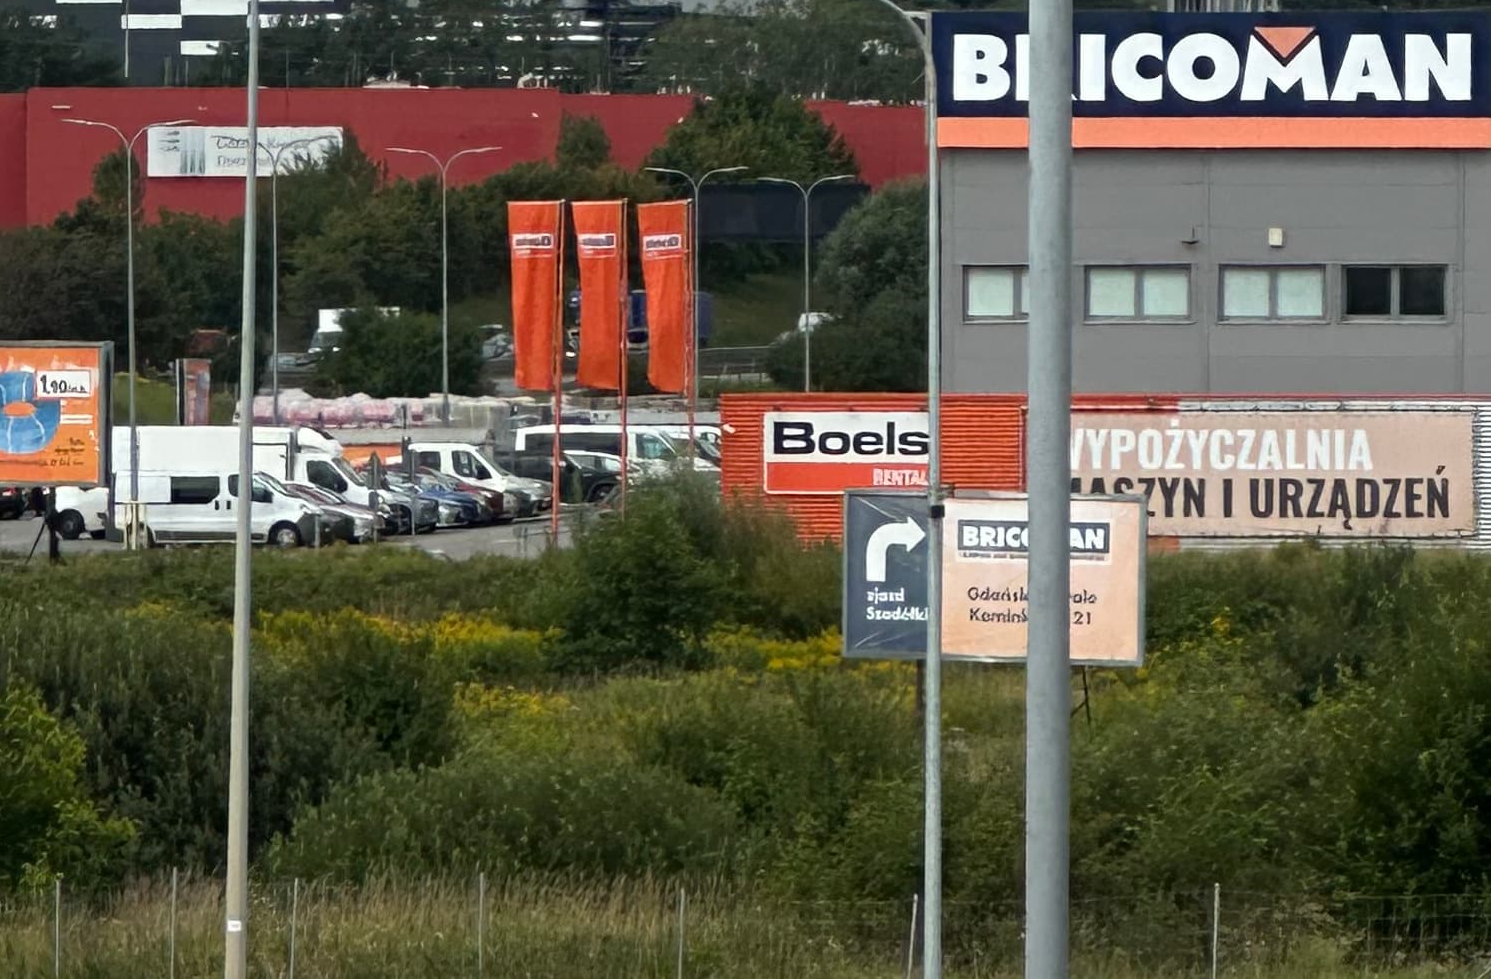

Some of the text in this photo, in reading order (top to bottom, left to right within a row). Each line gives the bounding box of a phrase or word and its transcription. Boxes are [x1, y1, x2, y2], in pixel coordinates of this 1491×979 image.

[953, 27, 1472, 102] BICOMAN
[773, 421, 929, 455] Boels
[1222, 478, 1233, 519] I
[1249, 464, 1450, 530] URZĄDZEŃ
[963, 526, 1105, 549] BRICAN
